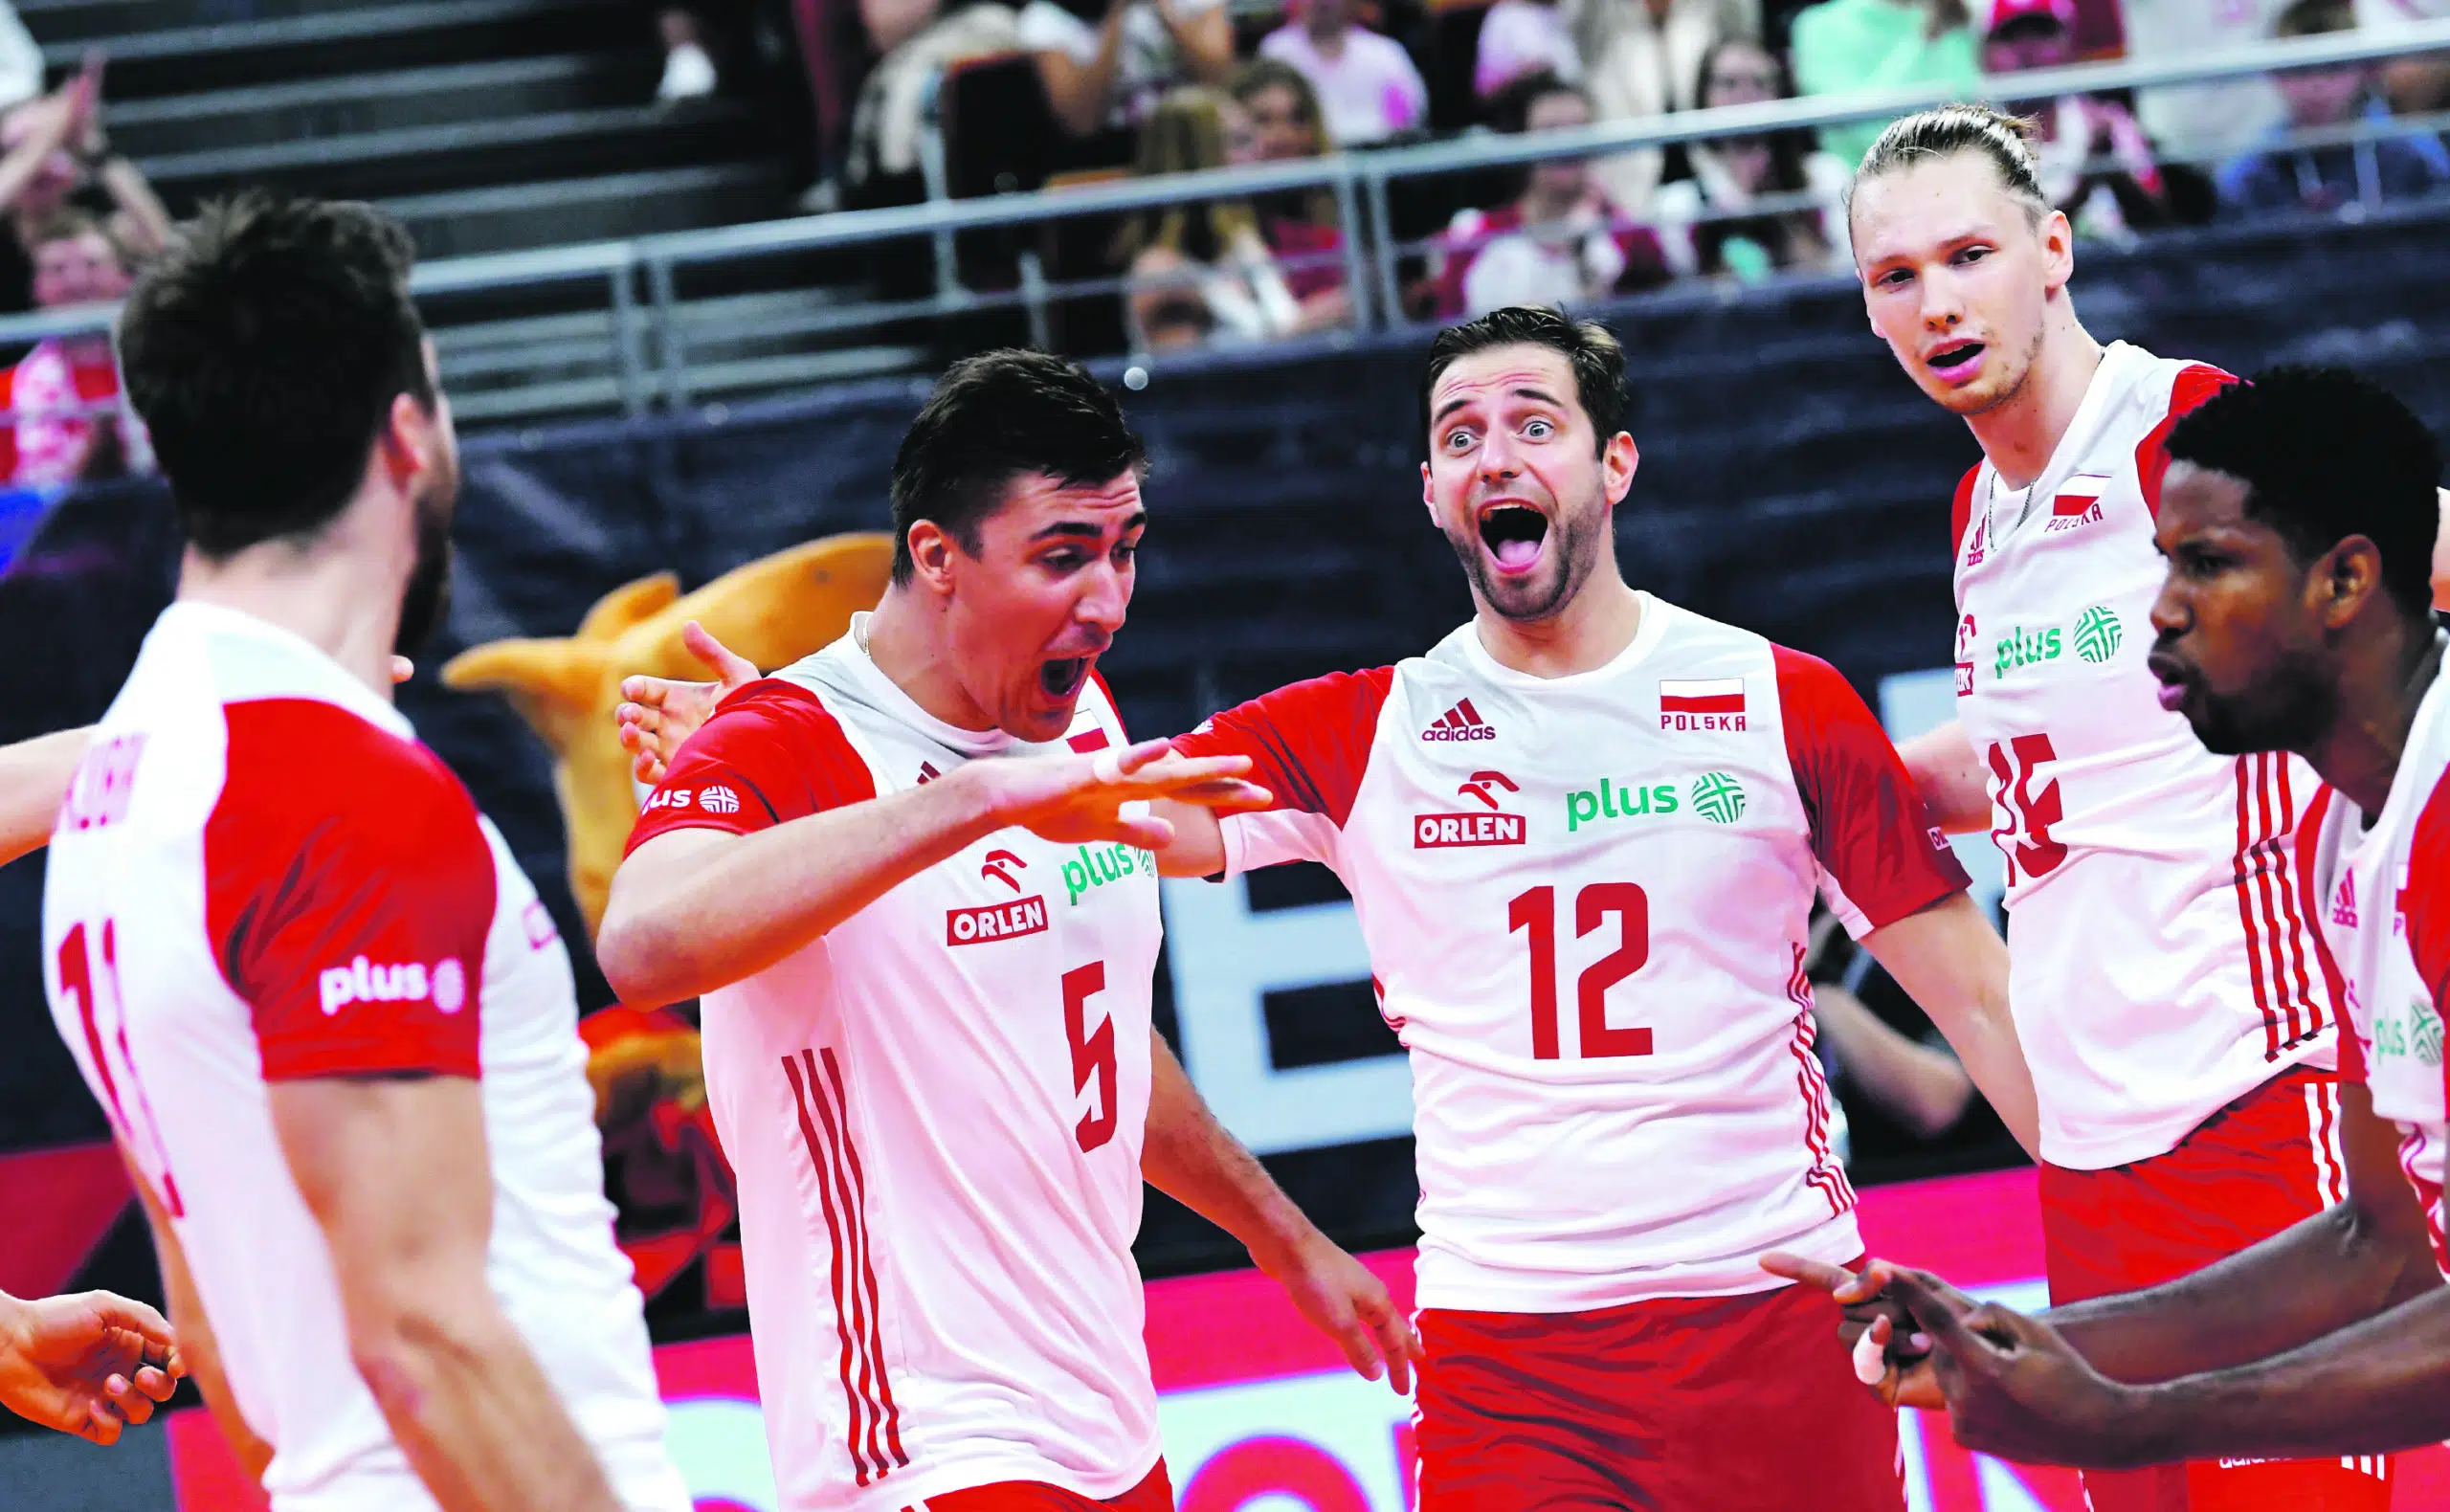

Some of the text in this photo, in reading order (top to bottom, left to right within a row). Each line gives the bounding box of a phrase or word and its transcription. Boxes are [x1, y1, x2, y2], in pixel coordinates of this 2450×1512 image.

[1994, 626, 2061, 678] plus
[1421, 724, 1497, 742] adidas
[1660, 714, 1747, 732] POLSKA
[1417, 815, 1519, 843] ORLEN
[1566, 777, 1680, 832] plus
[1988, 732, 2068, 888] 15
[1060, 843, 1134, 906] plus
[953, 900, 1044, 941] ORLEN
[319, 954, 428, 1015] plus
[1507, 881, 1654, 1060] 12
[1061, 960, 1118, 1154] 5
